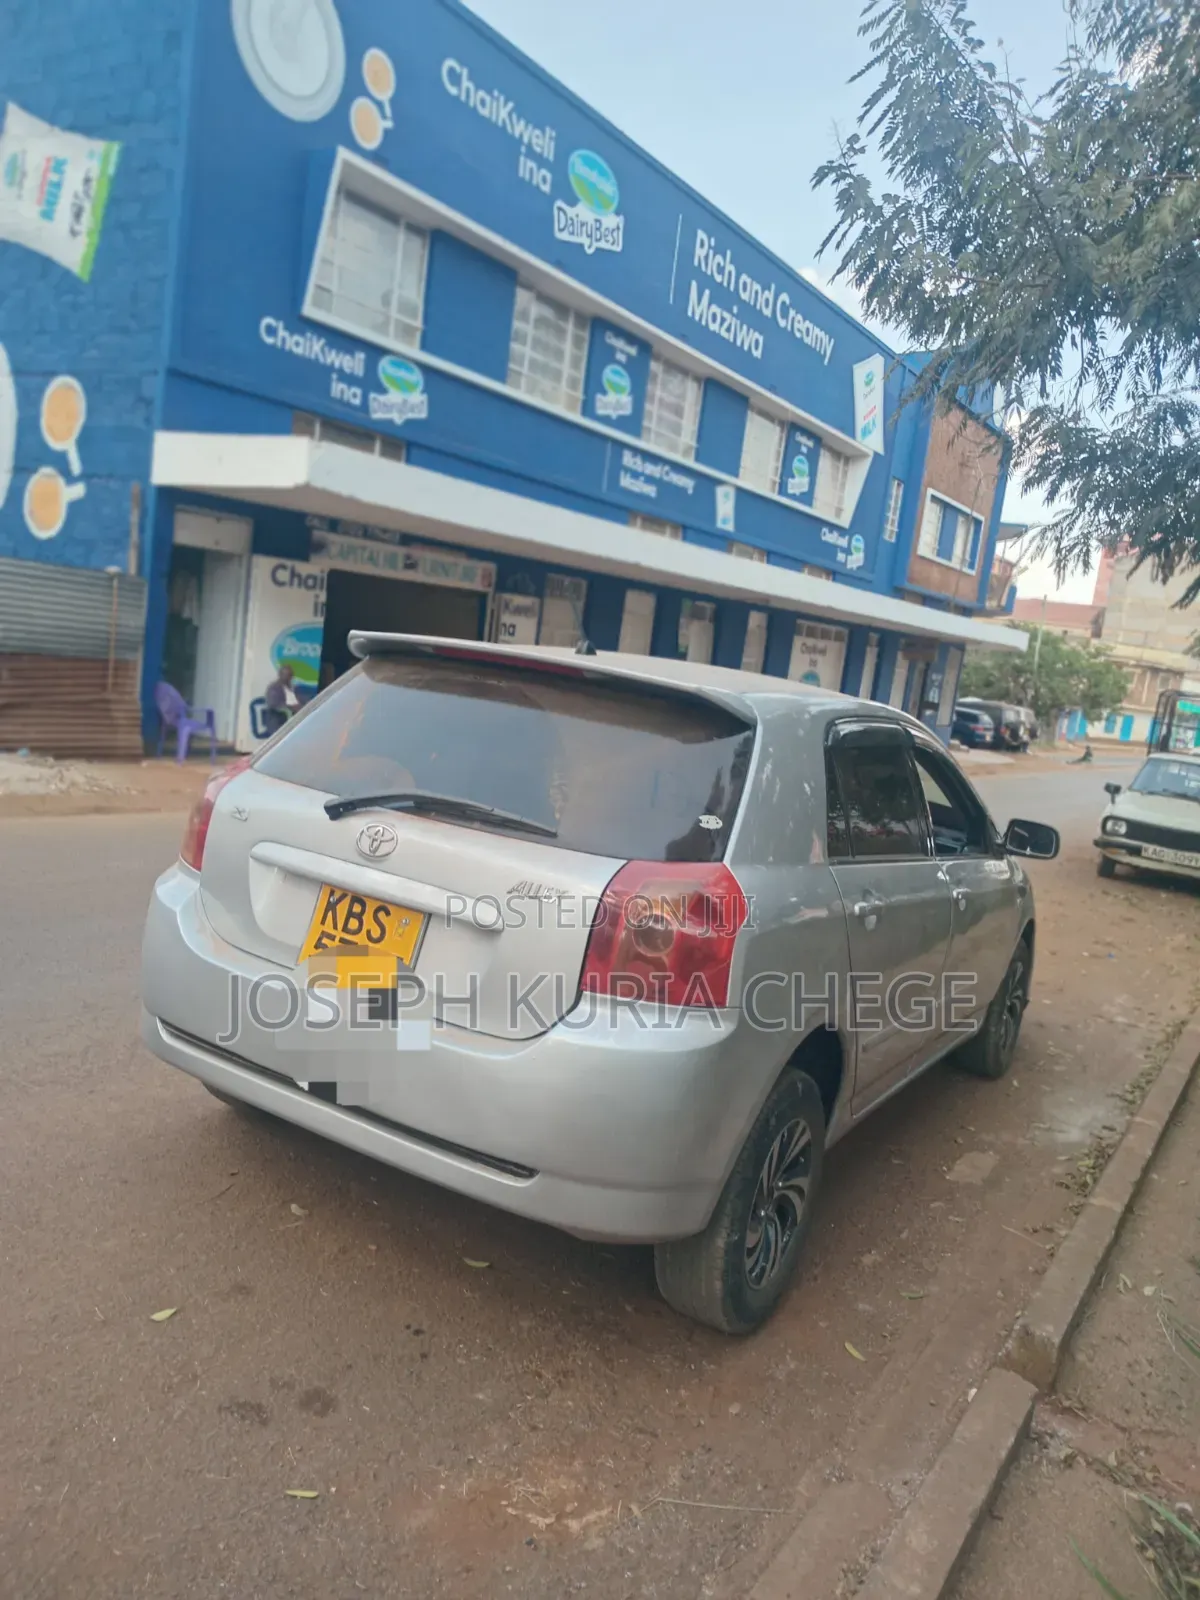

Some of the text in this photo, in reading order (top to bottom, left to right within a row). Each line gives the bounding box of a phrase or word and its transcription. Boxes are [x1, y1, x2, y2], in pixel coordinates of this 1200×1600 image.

[441, 57, 556, 162] ChaiKweli
[518, 145, 553, 195] ina
[555, 205, 622, 249] DairyBest
[687, 279, 764, 360] Maziwa
[693, 228, 835, 366] Rich and Creamy
[259, 315, 366, 378] ChaiKweli
[330, 373, 363, 407] ina
[270, 563, 326, 592] Chai
[320, 888, 392, 944] KBS
